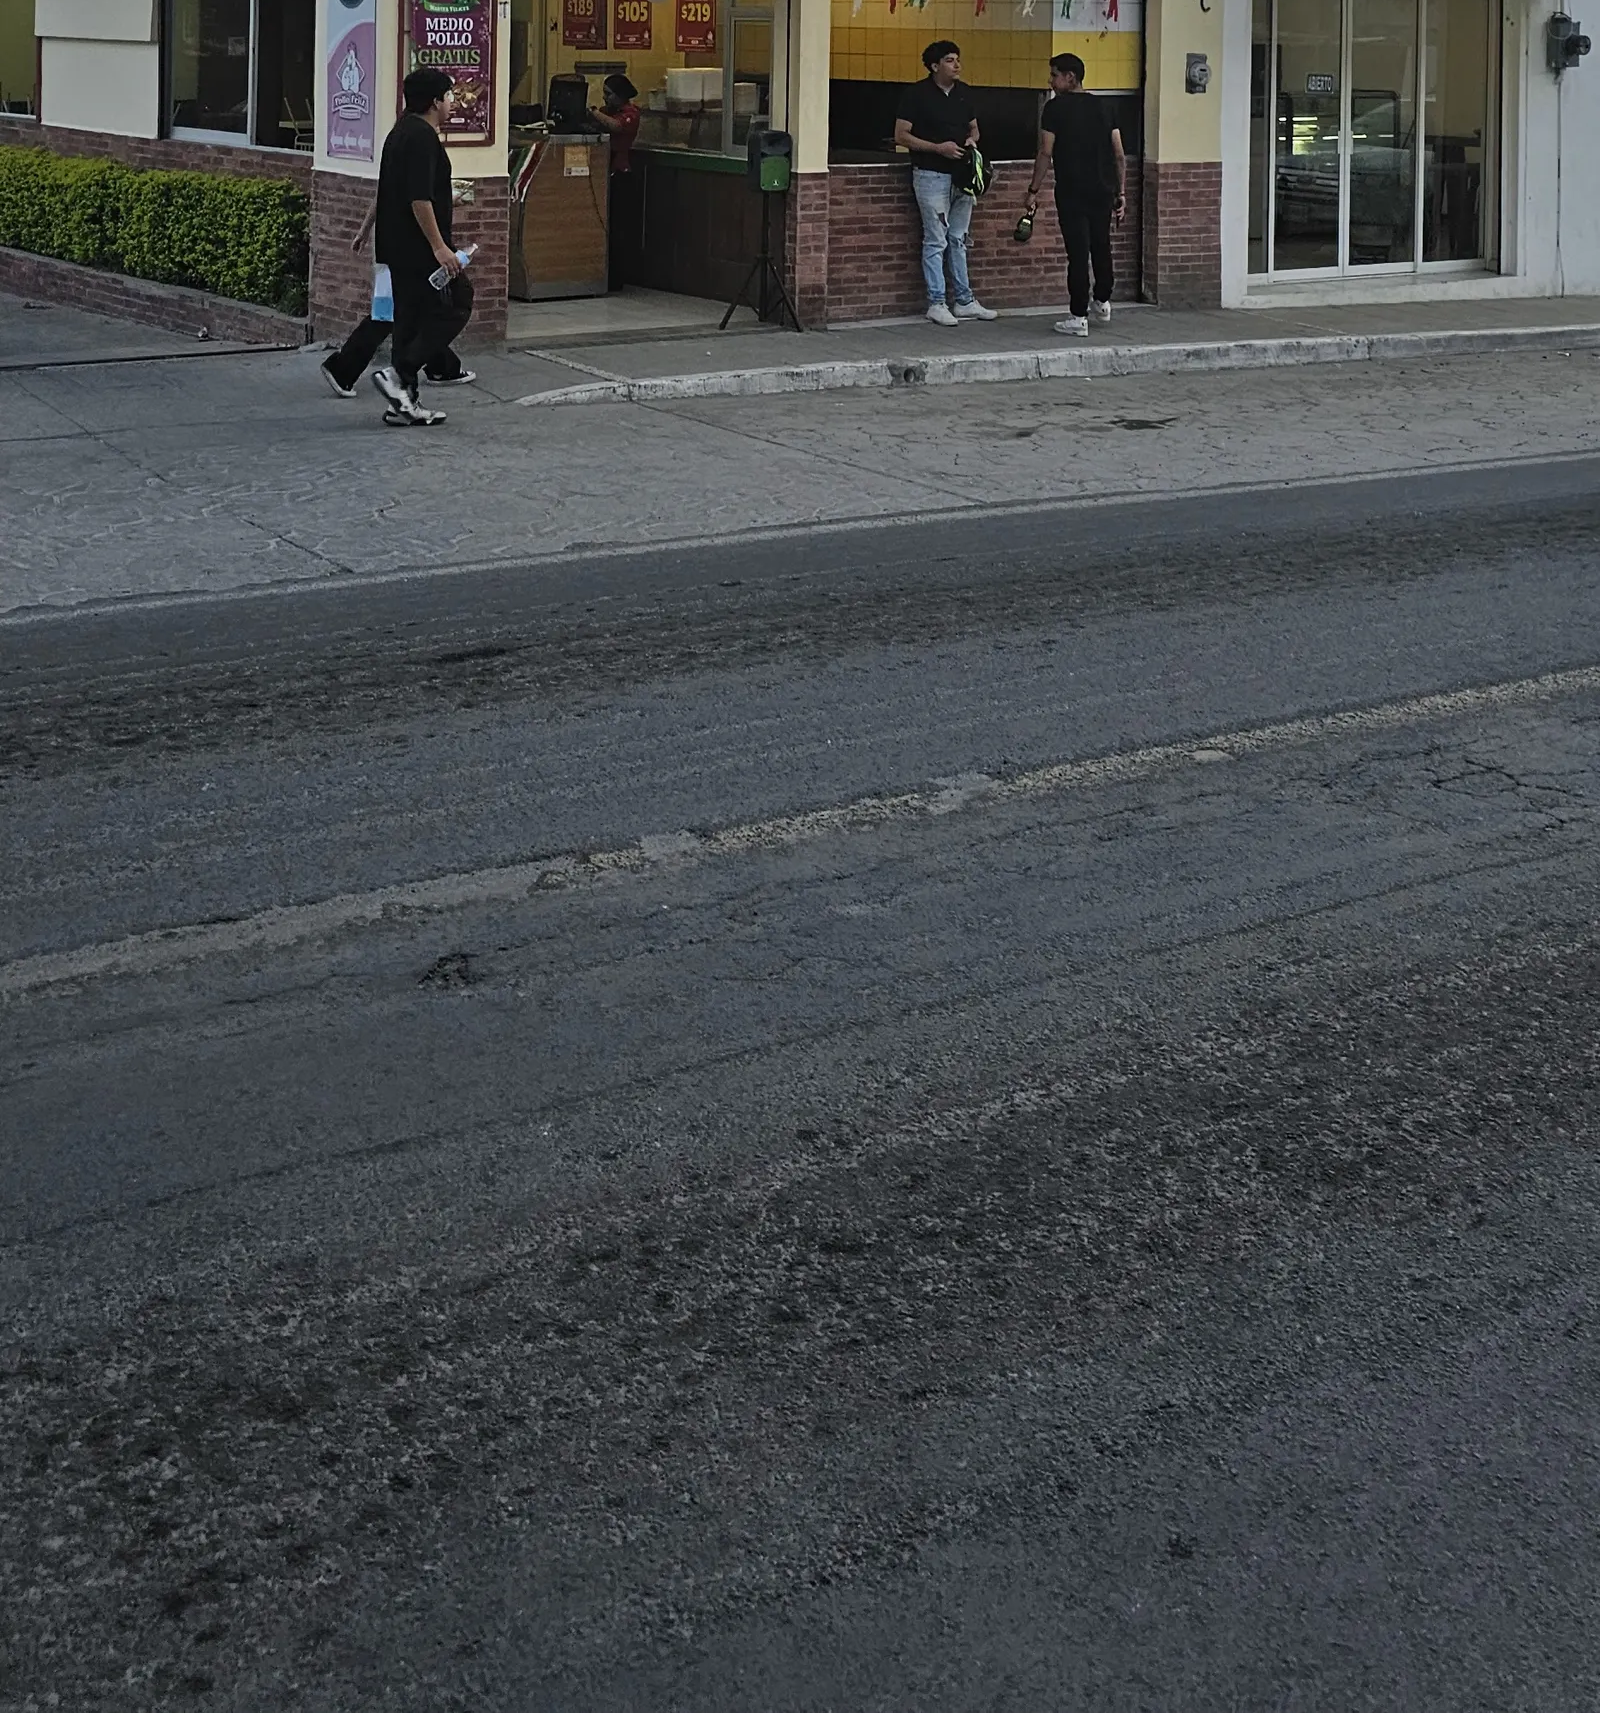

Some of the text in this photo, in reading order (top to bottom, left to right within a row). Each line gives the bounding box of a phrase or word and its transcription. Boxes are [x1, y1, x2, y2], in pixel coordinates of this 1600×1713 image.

[568, 0, 594, 16] $189
[618, 1, 648, 22] $105
[681, 3, 711, 22] $219
[426, 17, 474, 31] MEDIO
[427, 32, 472, 46] POLLO
[418, 49, 481, 65] GRATIS
[1308, 76, 1332, 91] ABIERTO
